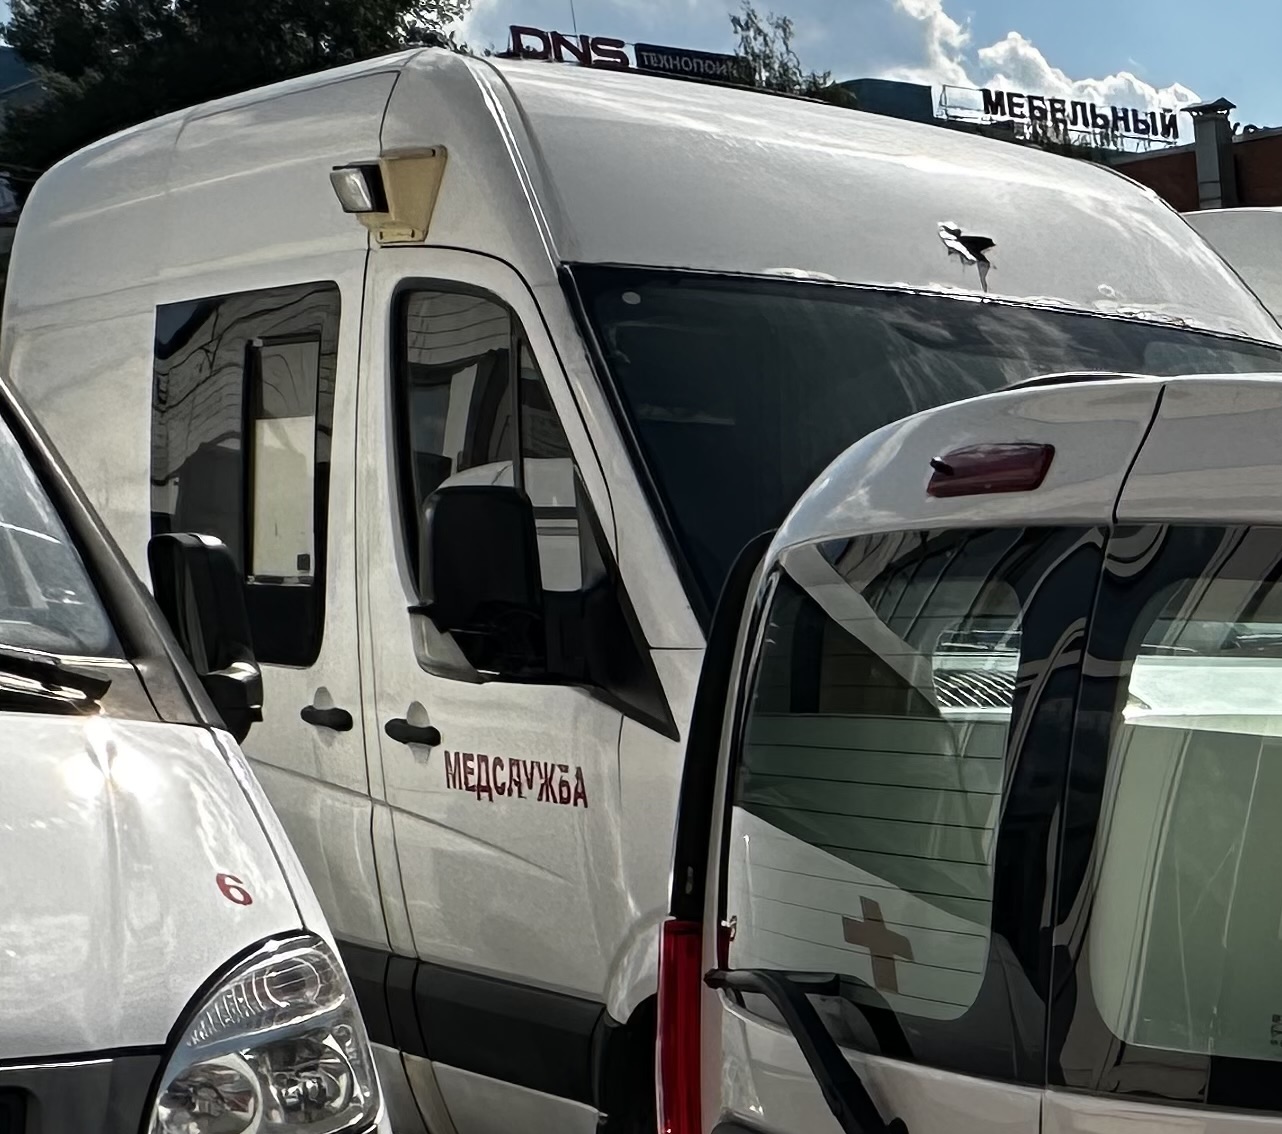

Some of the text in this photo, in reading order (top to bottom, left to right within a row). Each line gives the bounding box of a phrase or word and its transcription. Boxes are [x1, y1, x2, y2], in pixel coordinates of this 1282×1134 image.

[509, 25, 630, 67] DNS
[981, 88, 1180, 139] МЕБЕЛЬНЫЙ
[444, 750, 588, 808] МЕДСЛУЖБА
[216, 873, 253, 906] 6
